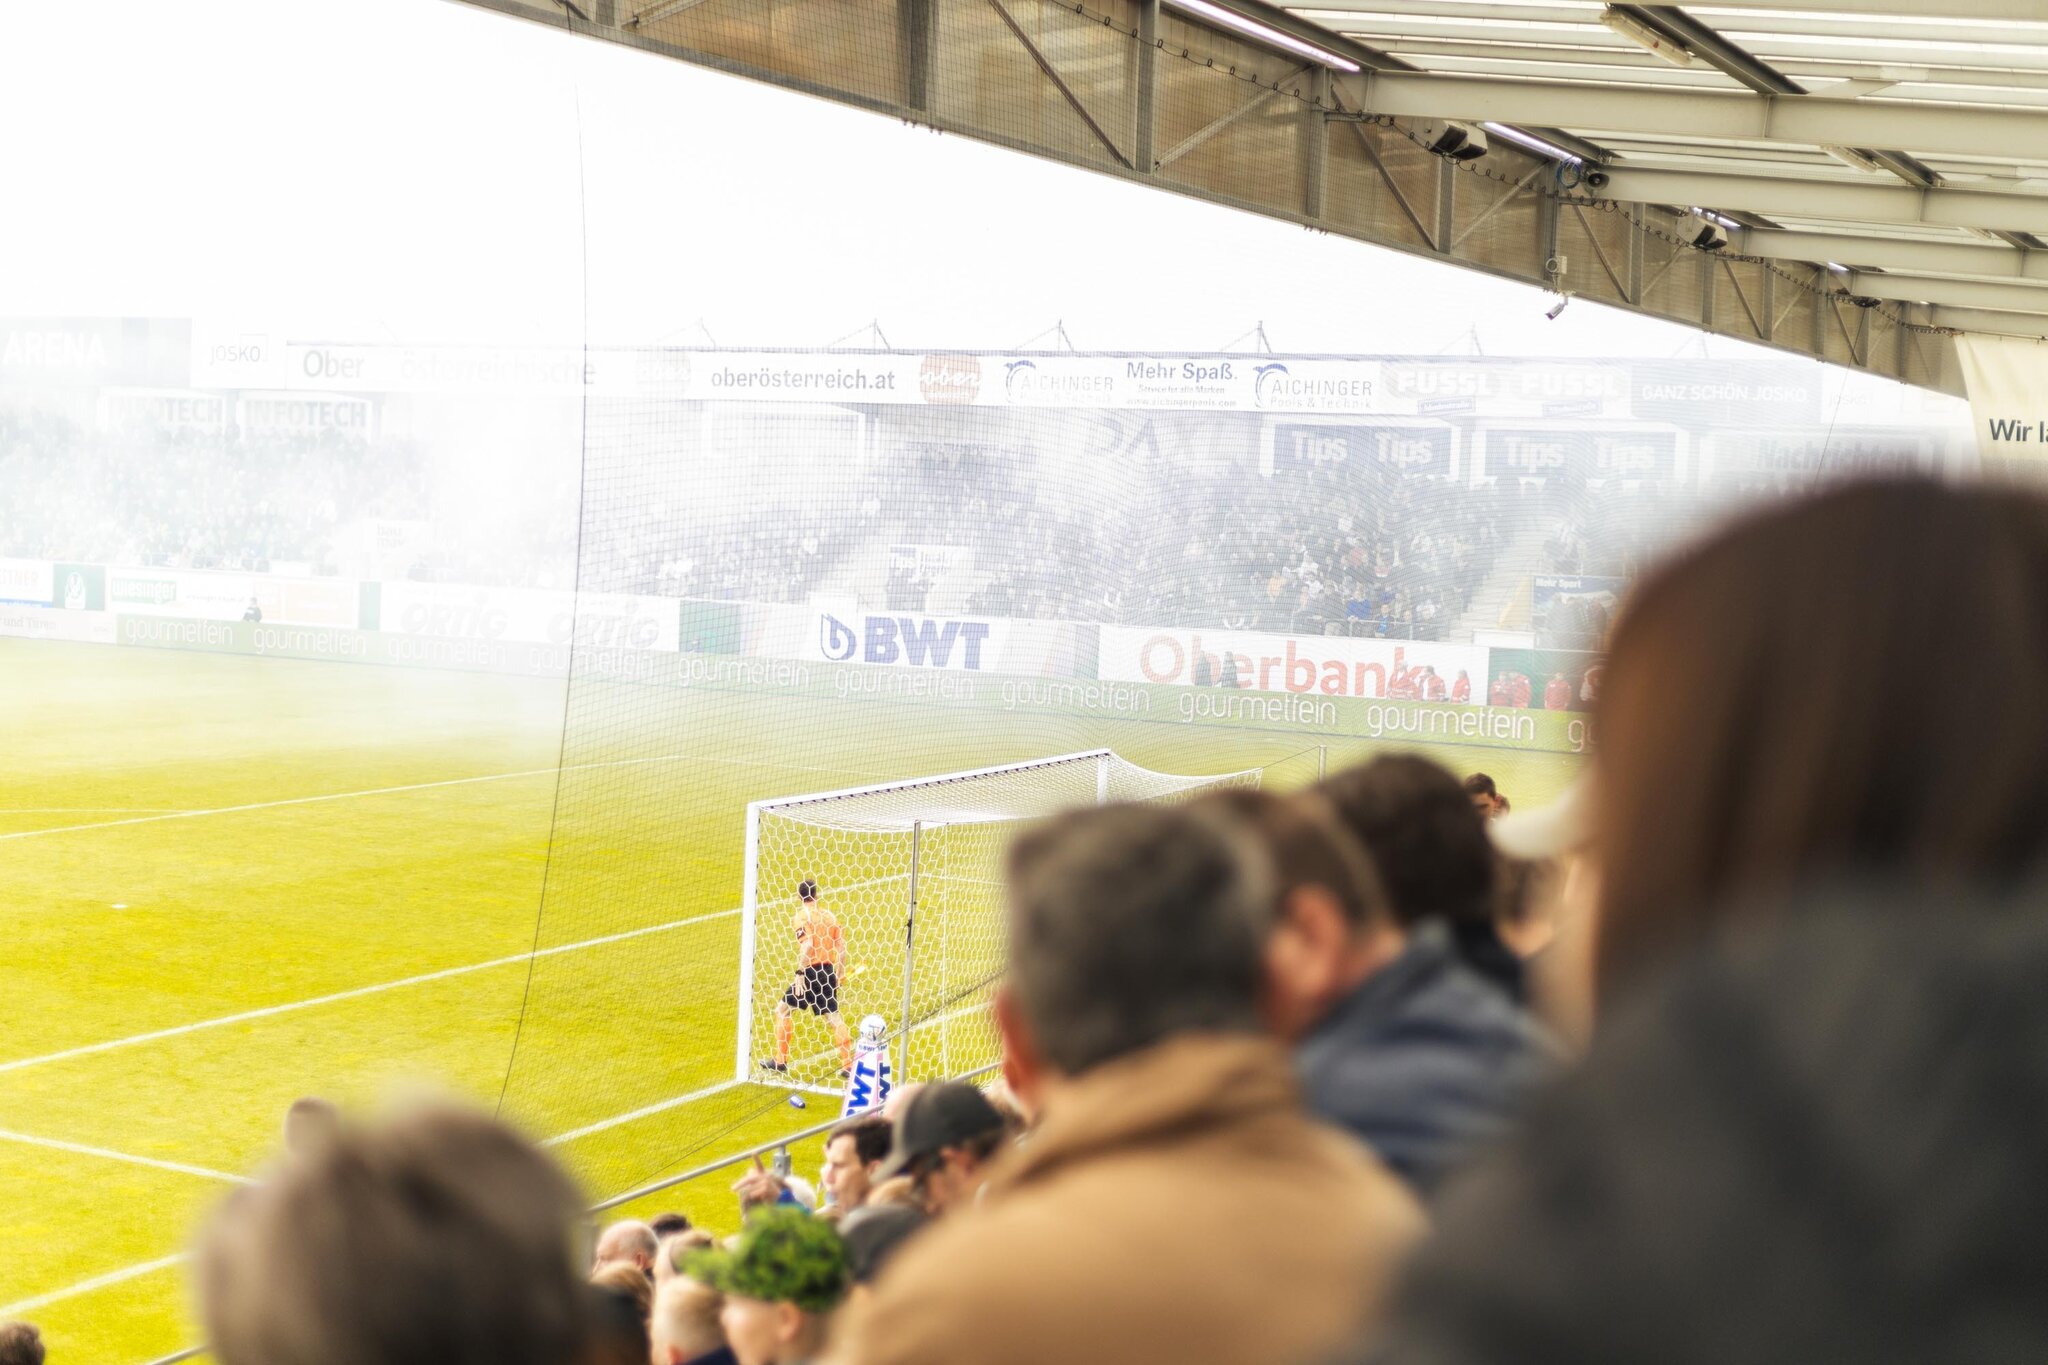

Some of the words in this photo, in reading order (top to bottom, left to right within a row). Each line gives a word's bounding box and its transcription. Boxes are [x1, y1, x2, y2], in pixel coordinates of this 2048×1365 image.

[2, 329, 106, 368] ARENA
[210, 344, 262, 366] JOSKO
[711, 365, 896, 391] oberösterreich.at
[1020, 374, 1114, 393] AICHINGER
[1126, 362, 1176, 380] Mehr
[1181, 362, 1238, 384] Spaß.
[1396, 369, 1492, 396] FUSSL
[1519, 371, 1619, 397] FUSSL
[1272, 380, 1373, 397] AICHINGER
[1642, 384, 1686, 401] GANZ
[1690, 382, 1748, 401] SCHÖN
[1755, 385, 1808, 402] JOSKO
[246, 400, 367, 428] INFOTECH
[1989, 418, 2033, 442] Wir
[1291, 430, 1350, 466] Tips
[1374, 432, 1435, 468] Tips
[1503, 437, 1566, 474] Tips
[1596, 437, 1658, 474] Tips
[864, 615, 990, 672] BWT
[126, 618, 233, 647] gourmetfein
[253, 626, 366, 657] gourmetfein
[388, 635, 507, 666] gourmetfein
[529, 645, 655, 677] gourmetfein
[677, 655, 810, 688] gourmetfein
[834, 666, 975, 699] gourmetfein
[1001, 679, 1150, 713] gourmetfein
[1179, 690, 1336, 726] gourmetfein
[1367, 702, 1535, 741] gourmetfein
